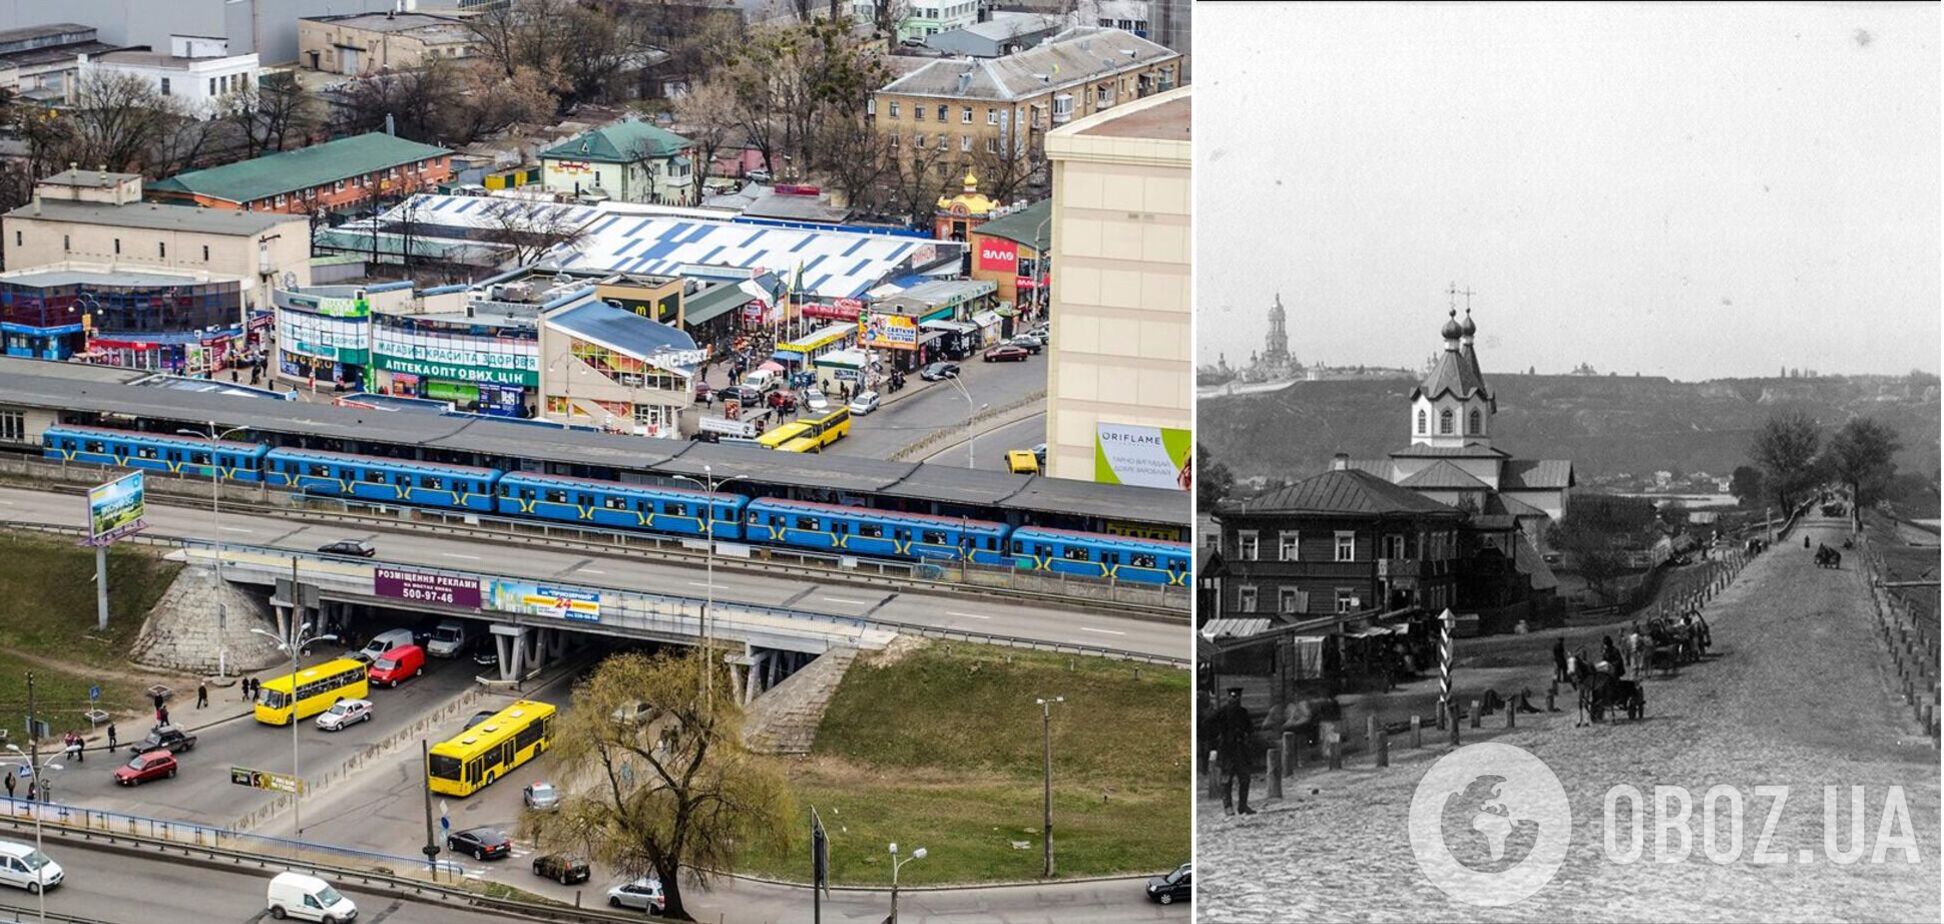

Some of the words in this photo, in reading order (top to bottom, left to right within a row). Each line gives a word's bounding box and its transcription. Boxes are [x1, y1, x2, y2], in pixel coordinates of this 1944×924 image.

[378, 343, 425, 360] МАГАЗИН
[426, 349, 462, 363] КРАСИ
[464, 353, 477, 363] ТА
[386, 359, 431, 375] АПТЕКА
[498, 372, 524, 384] ЦІН
[1102, 432, 1161, 445] ORIFLAME
[378, 569, 435, 584] РОЗМІЩЕННЯ
[437, 577, 478, 589] РЕКЛАМИ
[403, 588, 453, 603] 500-97-46
